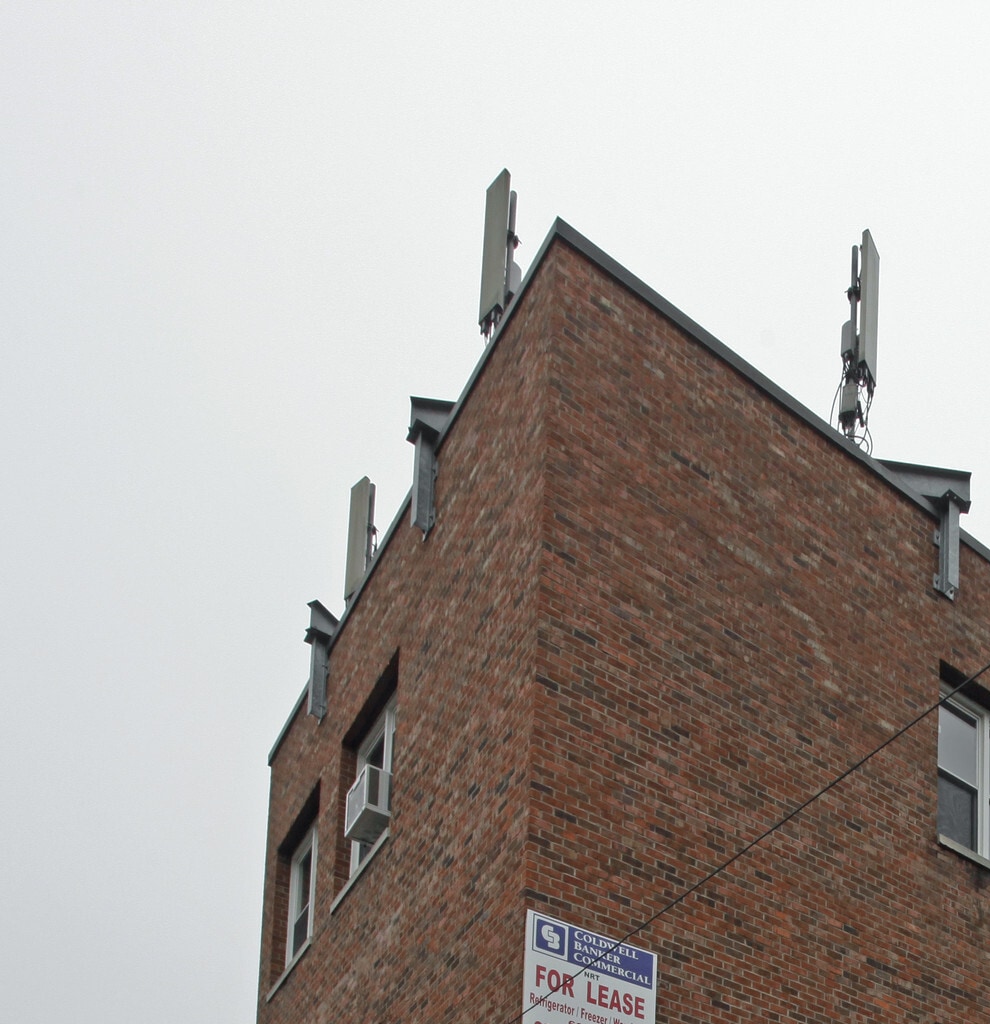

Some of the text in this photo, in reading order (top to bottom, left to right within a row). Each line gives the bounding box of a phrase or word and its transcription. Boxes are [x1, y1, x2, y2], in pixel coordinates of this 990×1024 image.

[574, 930, 639, 960] COLDWELL
[574, 942, 621, 965] BANKER
[573, 952, 651, 985] COMMERCIAL
[584, 971, 600, 981] NRT
[529, 992, 575, 1016] Refrigerator
[535, 965, 645, 1019] FOR LEASE
